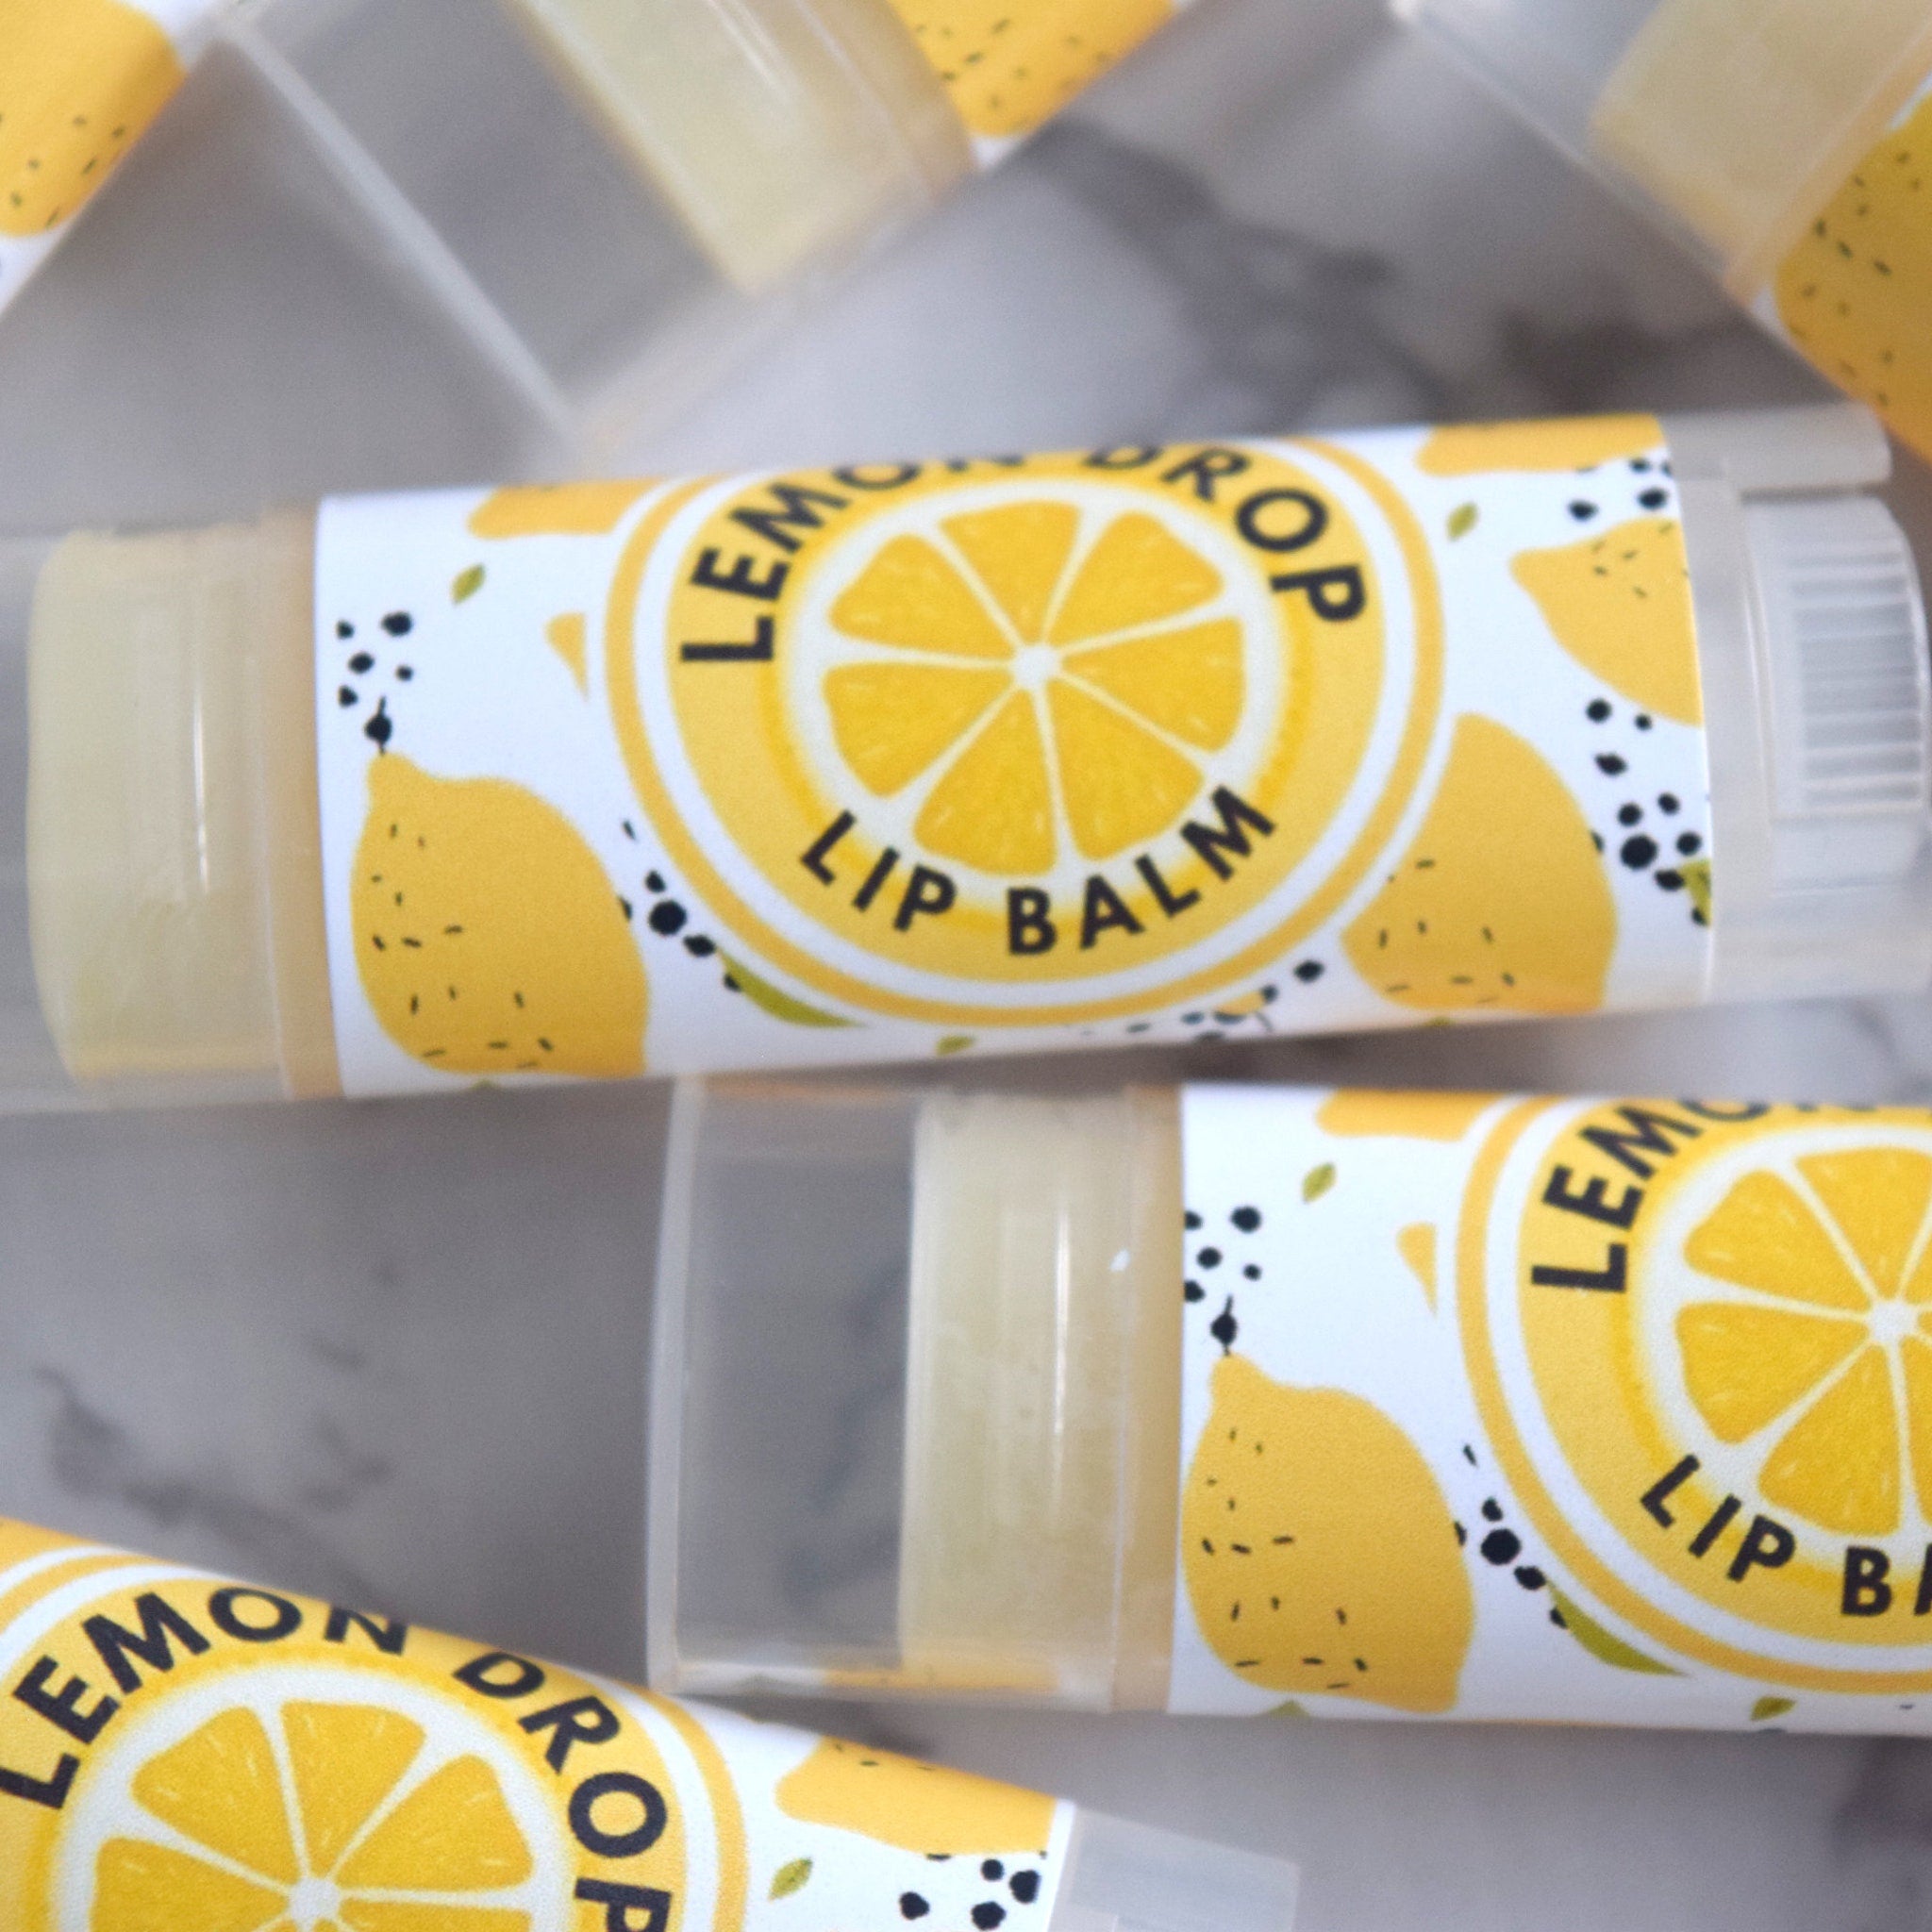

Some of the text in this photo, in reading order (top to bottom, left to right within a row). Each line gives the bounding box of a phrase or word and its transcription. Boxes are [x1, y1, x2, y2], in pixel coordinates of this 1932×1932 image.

[800, 786, 1274, 957] LIP BALM
[1639, 1454, 1797, 1583] LIP
[0, 1587, 673, 1932] LEMON DROP
